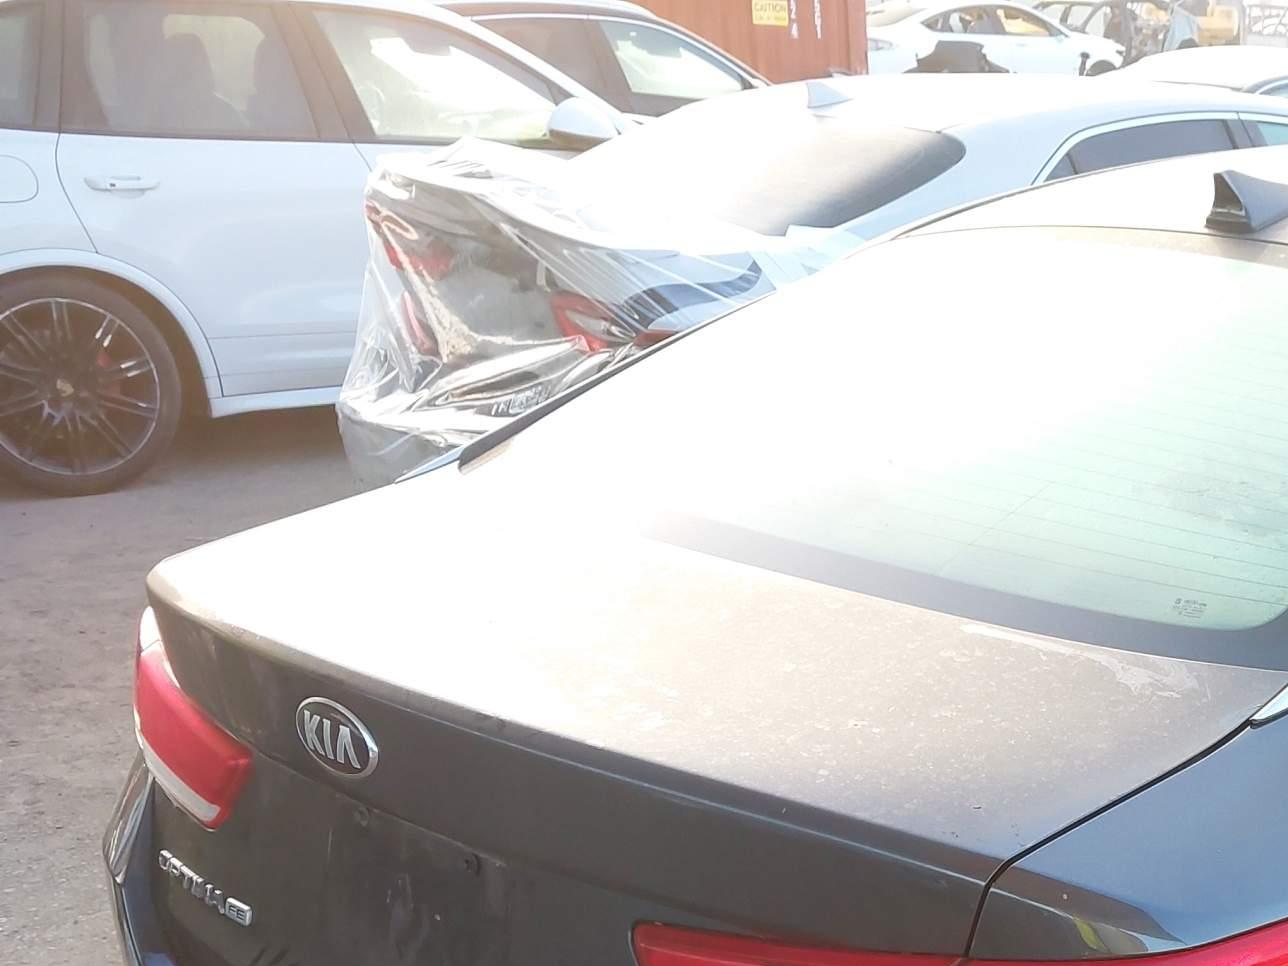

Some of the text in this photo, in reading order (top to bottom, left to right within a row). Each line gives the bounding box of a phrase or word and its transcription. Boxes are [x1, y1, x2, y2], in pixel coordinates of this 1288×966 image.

[754, 2, 786, 13] CAUTION
[303, 709, 361, 769] KIA
[158, 848, 225, 915] OPTIMA
